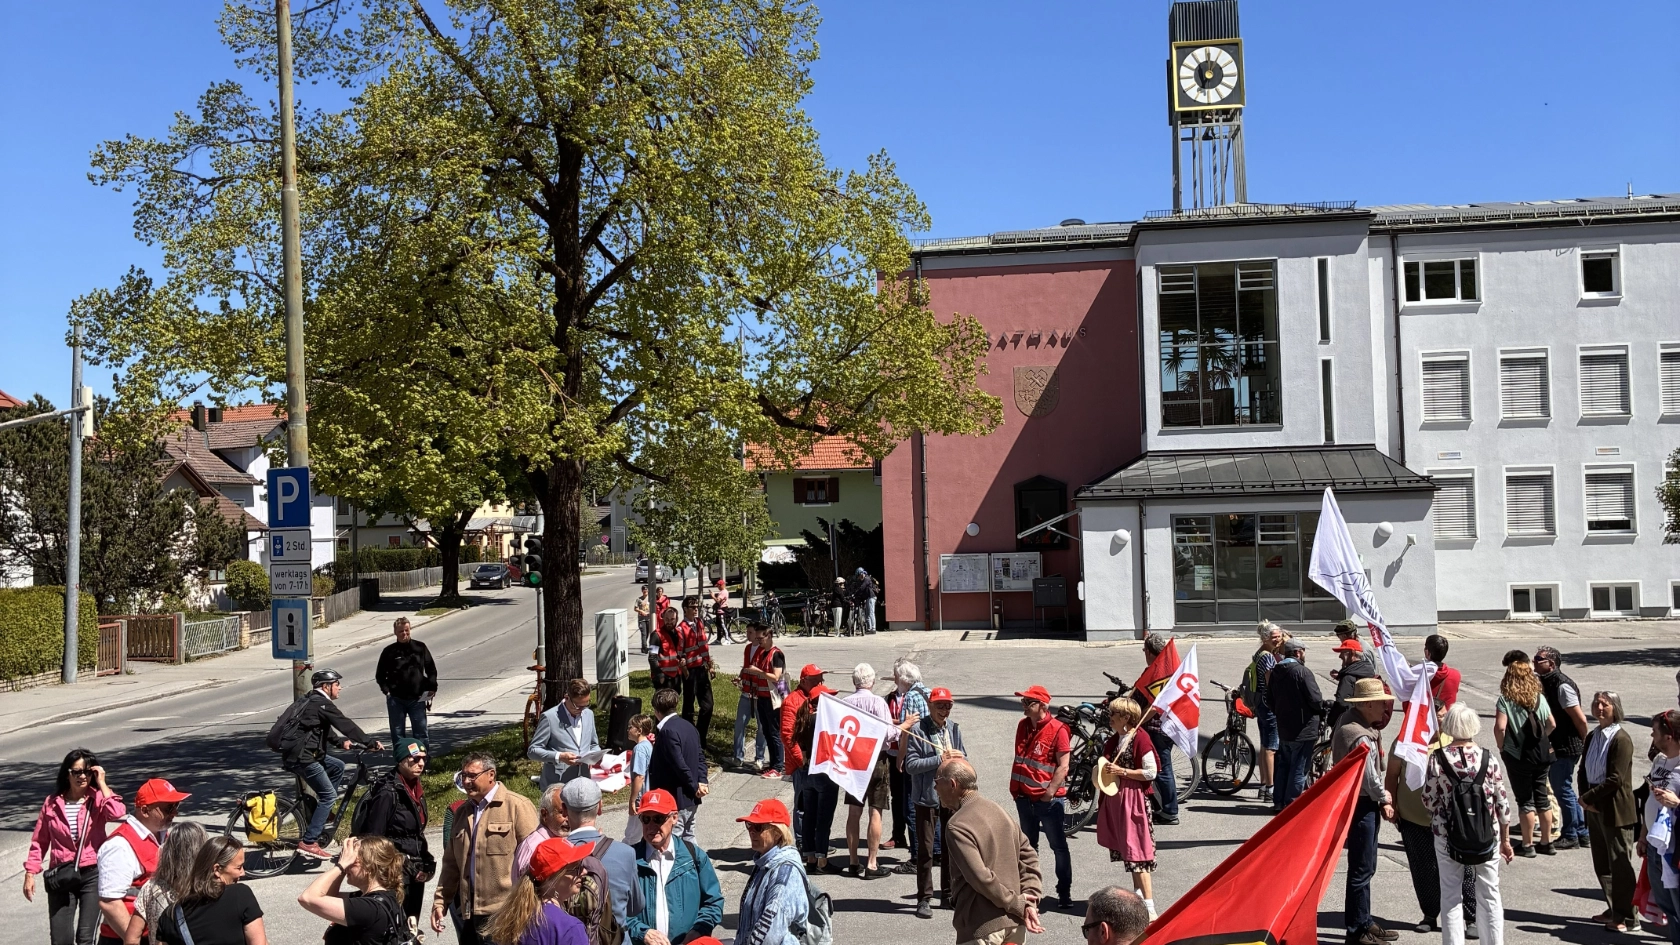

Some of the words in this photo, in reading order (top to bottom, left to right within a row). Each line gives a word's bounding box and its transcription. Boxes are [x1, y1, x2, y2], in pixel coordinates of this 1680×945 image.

[276, 476, 300, 521] P
[286, 541, 291, 551] 2
[292, 541, 308, 551] Std.
[274, 569, 308, 581] werktags
[274, 583, 287, 591] von
[289, 580, 303, 590] 7-17
